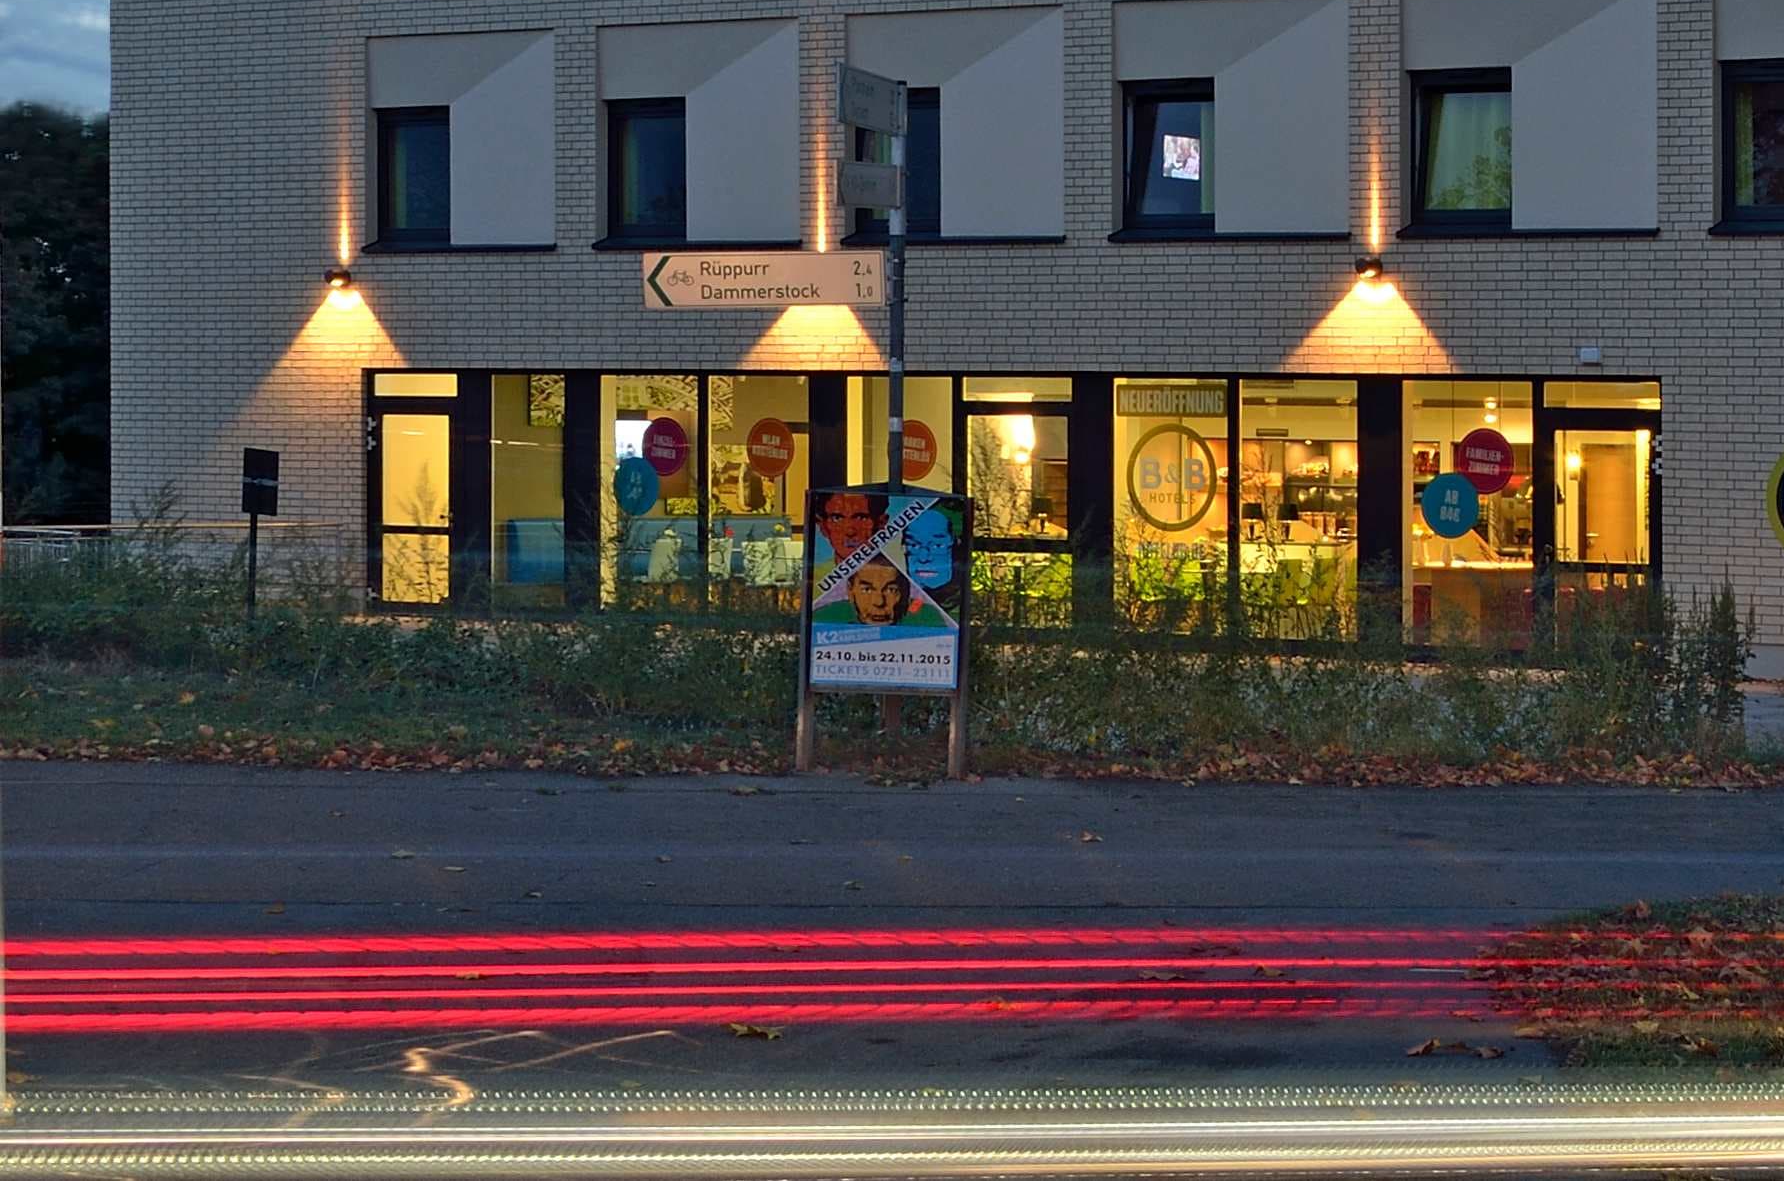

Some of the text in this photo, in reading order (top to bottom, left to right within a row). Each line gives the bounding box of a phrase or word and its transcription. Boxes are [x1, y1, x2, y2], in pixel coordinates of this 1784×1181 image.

[700, 260, 770, 280] Rüppurr
[701, 283, 821, 300] Dammerstock
[1119, 386, 1225, 414] NEUERÖFFNUNG
[1140, 457, 1206, 490] B&B
[1149, 492, 1197, 506] HOTELS
[869, 500, 925, 551] FRAUEN
[815, 650, 951, 665] 24.10. bis 22.11.2015
[816, 664, 869, 676] TICKETS
[873, 666, 902, 677] 0721
